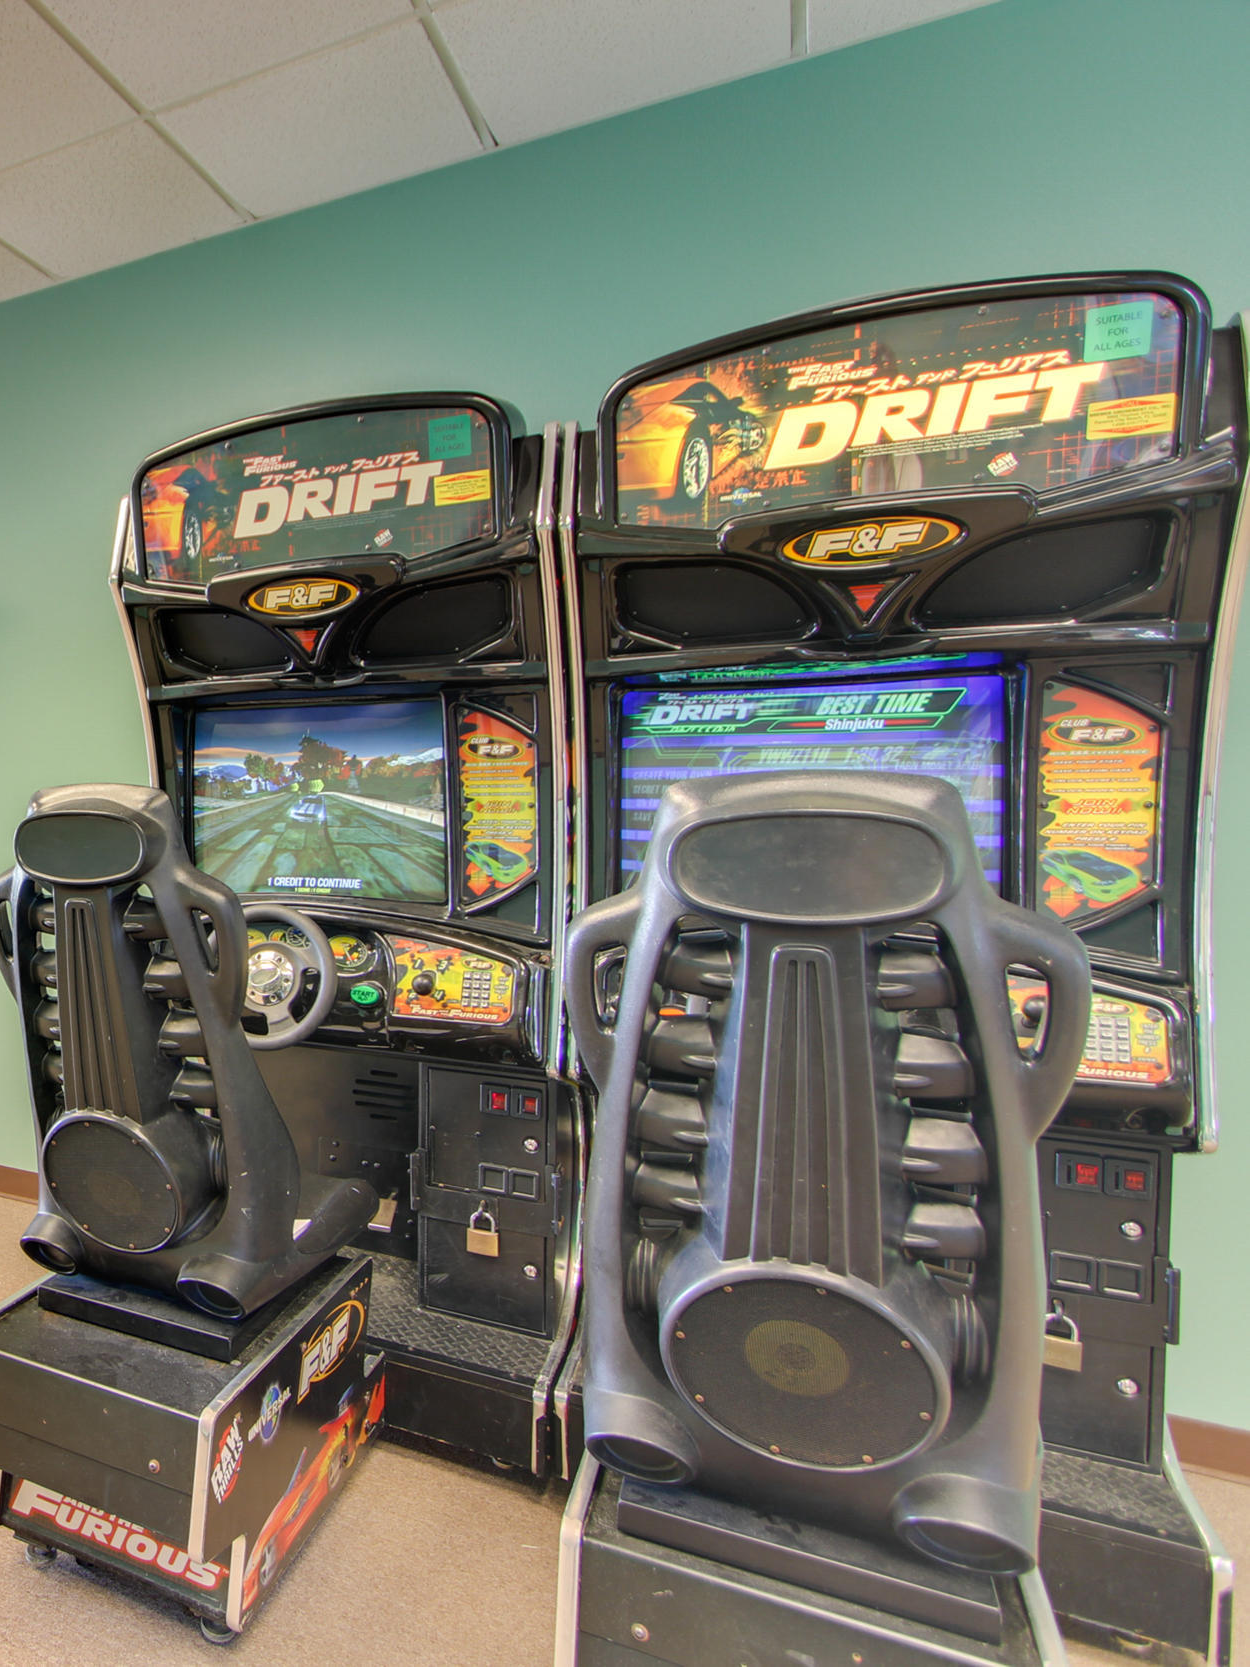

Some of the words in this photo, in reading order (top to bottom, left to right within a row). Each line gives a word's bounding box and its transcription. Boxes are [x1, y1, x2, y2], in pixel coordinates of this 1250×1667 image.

[1095, 310, 1143, 326] SUITABLE
[1107, 327, 1129, 337] FOR
[1093, 342, 1112, 352] ALL
[1114, 337, 1142, 350] AGES
[805, 361, 855, 376] FAST
[788, 367, 878, 390] FURIOUS
[762, 361, 1106, 471] DRIFT
[243, 460, 299, 476] FURIOUS
[232, 460, 444, 540] DRIFT
[809, 522, 926, 559] F&F
[265, 583, 338, 609] F&F
[816, 695, 873, 715] BEST
[873, 692, 934, 713] TIME
[646, 704, 752, 725] DRIFT
[824, 717, 886, 732] Shinjuku
[1060, 719, 1090, 727] CLUB
[1069, 728, 1129, 741] F&F
[478, 744, 516, 755] F&F
[273, 876, 303, 887] CREDIT
[304, 877, 316, 887] TO
[317, 877, 363, 889] CONTINUE
[351, 989, 375, 999] START
[411, 1007, 439, 1016] FAST
[448, 1009, 500, 1020] FURIOUS
[298, 1307, 350, 1402] F&F
[248, 1386, 291, 1442] UNIVERSAL
[11, 1478, 221, 1589] FURIOUS
